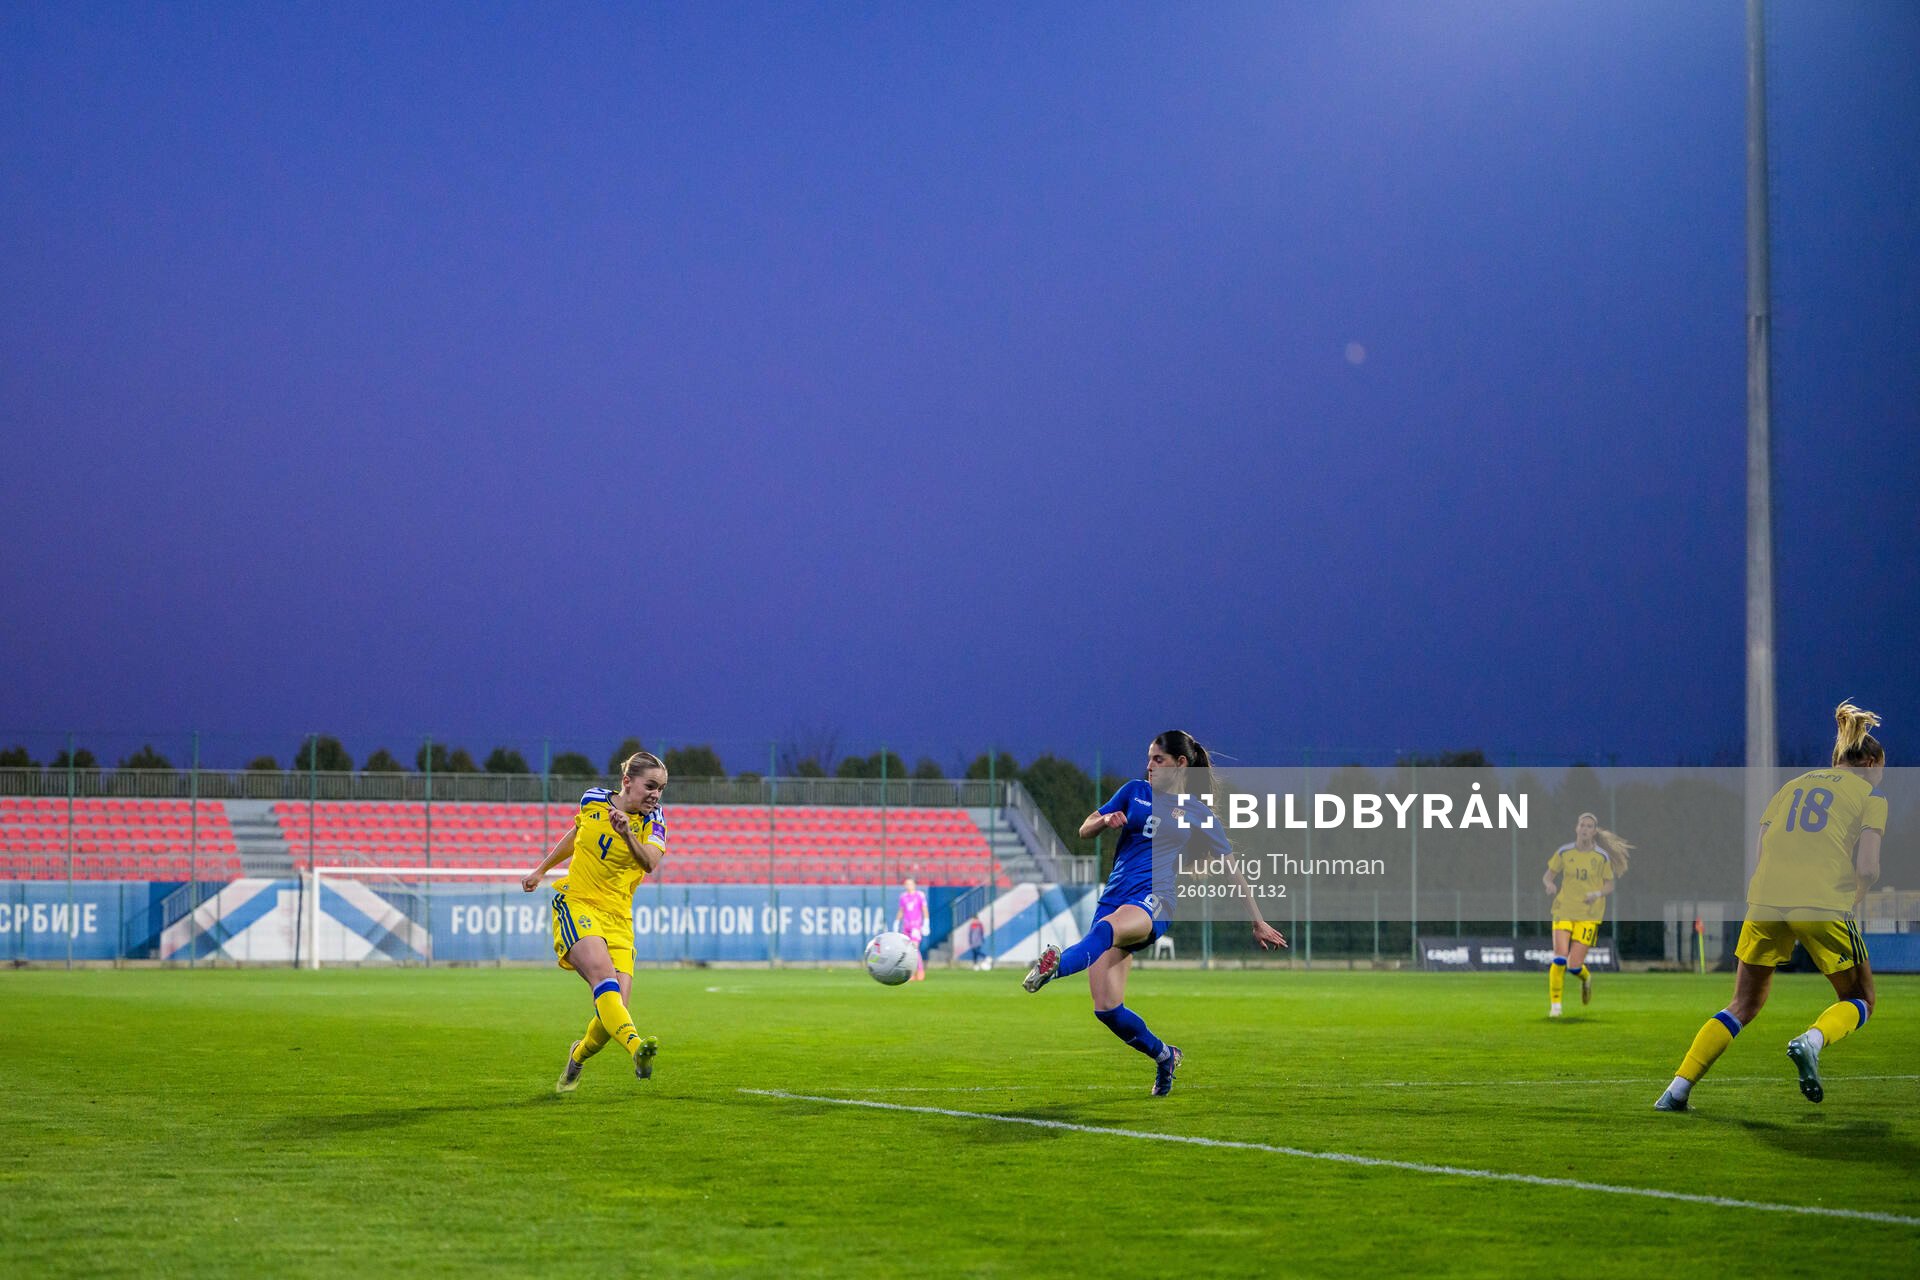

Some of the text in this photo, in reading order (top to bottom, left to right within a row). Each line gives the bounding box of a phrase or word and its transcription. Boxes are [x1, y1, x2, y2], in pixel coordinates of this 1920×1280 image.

[1786, 787, 1834, 832] 18
[1142, 814, 1161, 838] 8
[598, 833, 613, 860] 4
[1576, 868, 1588, 881] 13
[451, 905, 888, 935] FOOTBA OCIATION OF SERBIA
[1582, 927, 1593, 942] 13
